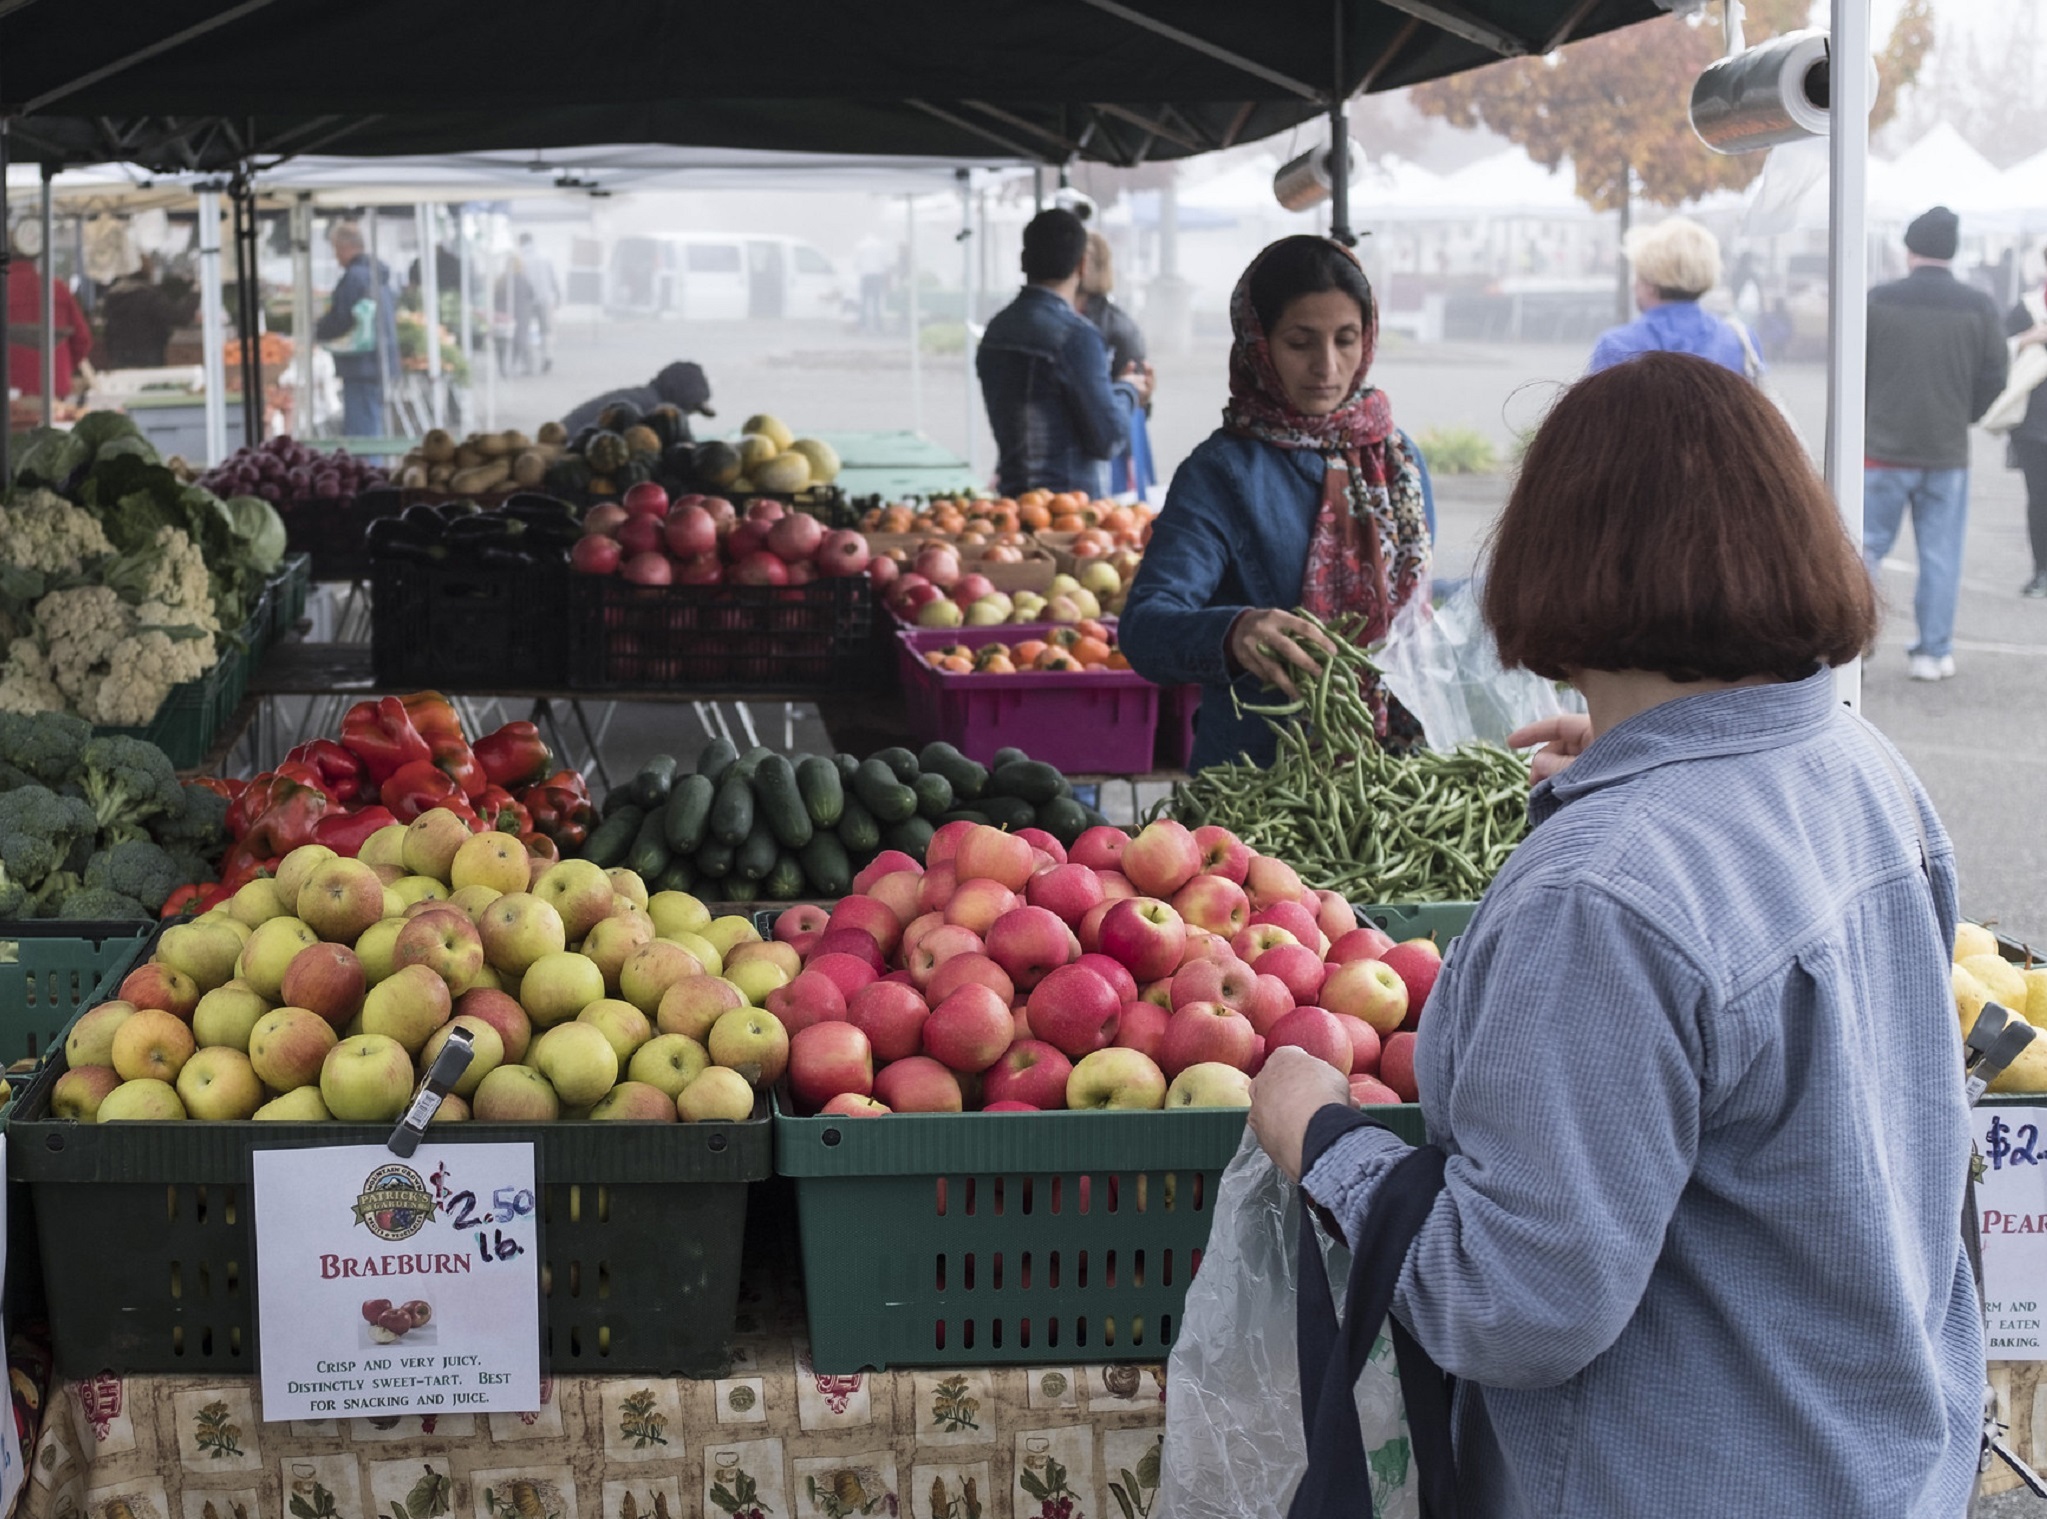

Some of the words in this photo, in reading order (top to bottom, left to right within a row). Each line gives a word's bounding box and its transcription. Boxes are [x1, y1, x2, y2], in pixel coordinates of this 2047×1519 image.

[1986, 1115, 2047, 1171] $2.
[366, 1167, 400, 1191] MOUNTAIN
[401, 1168, 423, 1191] GROWN
[361, 1192, 429, 1204] PATRICK'S
[373, 1201, 417, 1209] GARDEN
[320, 1253, 472, 1280] BRAEBURN
[1985, 1301, 2001, 1312] RM
[2009, 1301, 2040, 1312] AND
[2000, 1319, 2040, 1330] EATEN
[1990, 1337, 2040, 1347] BAKING.
[317, 1360, 356, 1373] CRISP
[363, 1359, 392, 1371] AND
[400, 1357, 435, 1368] VERY
[443, 1355, 481, 1369] JUICY.
[287, 1380, 364, 1393] DISTINCTLY
[372, 1375, 462, 1389] SWEET-TART.
[479, 1372, 511, 1385] BEST
[310, 1400, 336, 1411] FOR
[344, 1396, 409, 1410] SNACKING
[417, 1393, 444, 1405] AND
[453, 1392, 489, 1406] JUICE.
